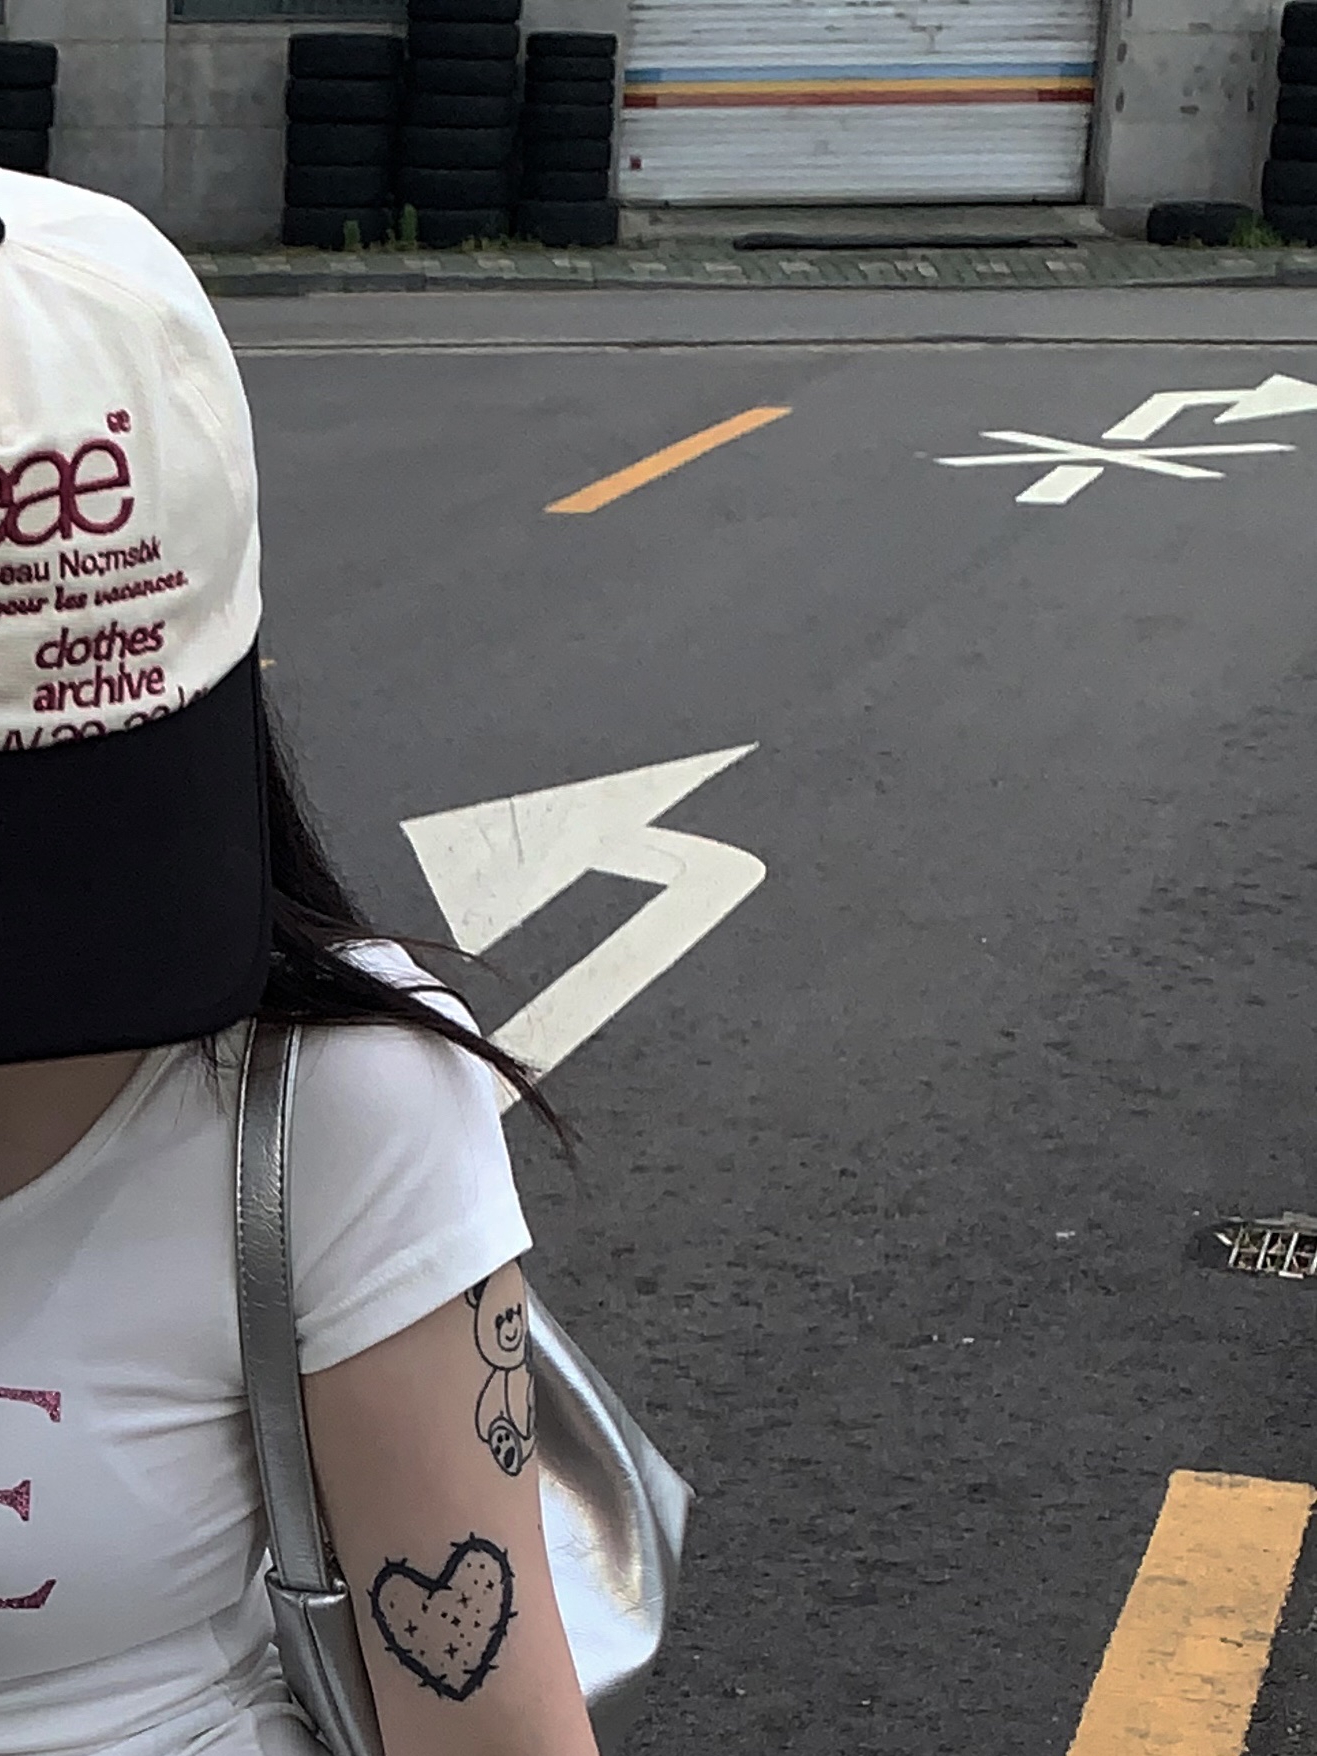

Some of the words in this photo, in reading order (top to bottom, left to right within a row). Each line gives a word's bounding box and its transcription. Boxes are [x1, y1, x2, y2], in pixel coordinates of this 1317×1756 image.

[54, 584, 88, 612] les
[34, 618, 166, 670] clothes
[32, 661, 166, 713] archive
